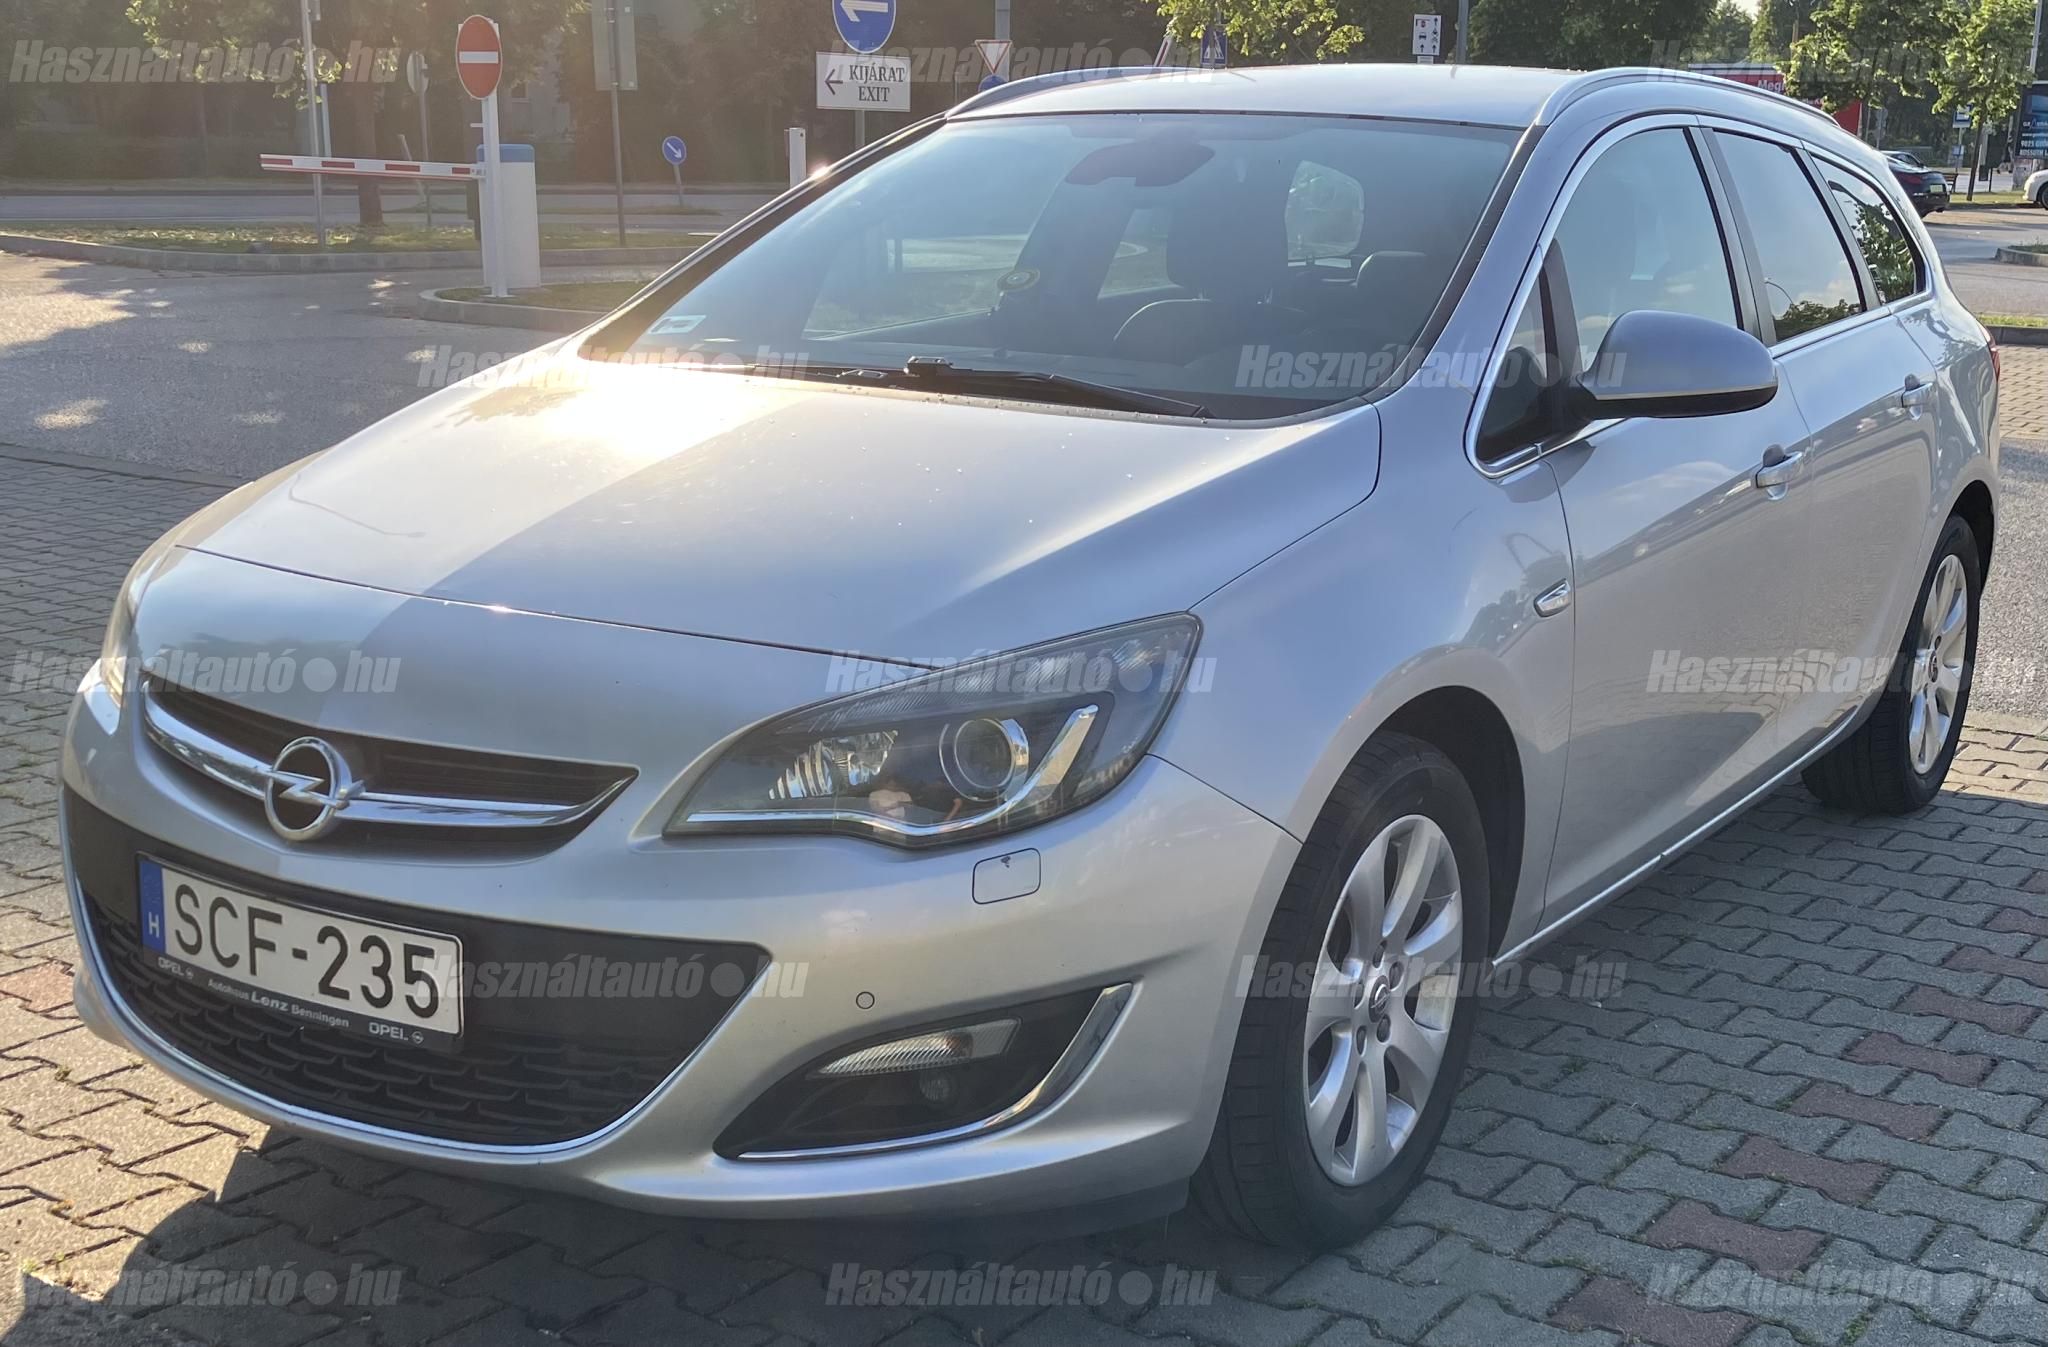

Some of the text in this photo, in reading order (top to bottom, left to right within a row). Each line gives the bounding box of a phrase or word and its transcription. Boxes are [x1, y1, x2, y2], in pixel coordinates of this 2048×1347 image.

[849, 62, 905, 84] KIJÁRAT
[858, 86, 890, 102] EXIT
[148, 911, 160, 938] H
[174, 883, 440, 1019] SCF-235
[157, 956, 186, 978] OPEL
[207, 978, 350, 1028] Autohaus Lenz Benningen
[368, 1021, 409, 1041] OPEL
